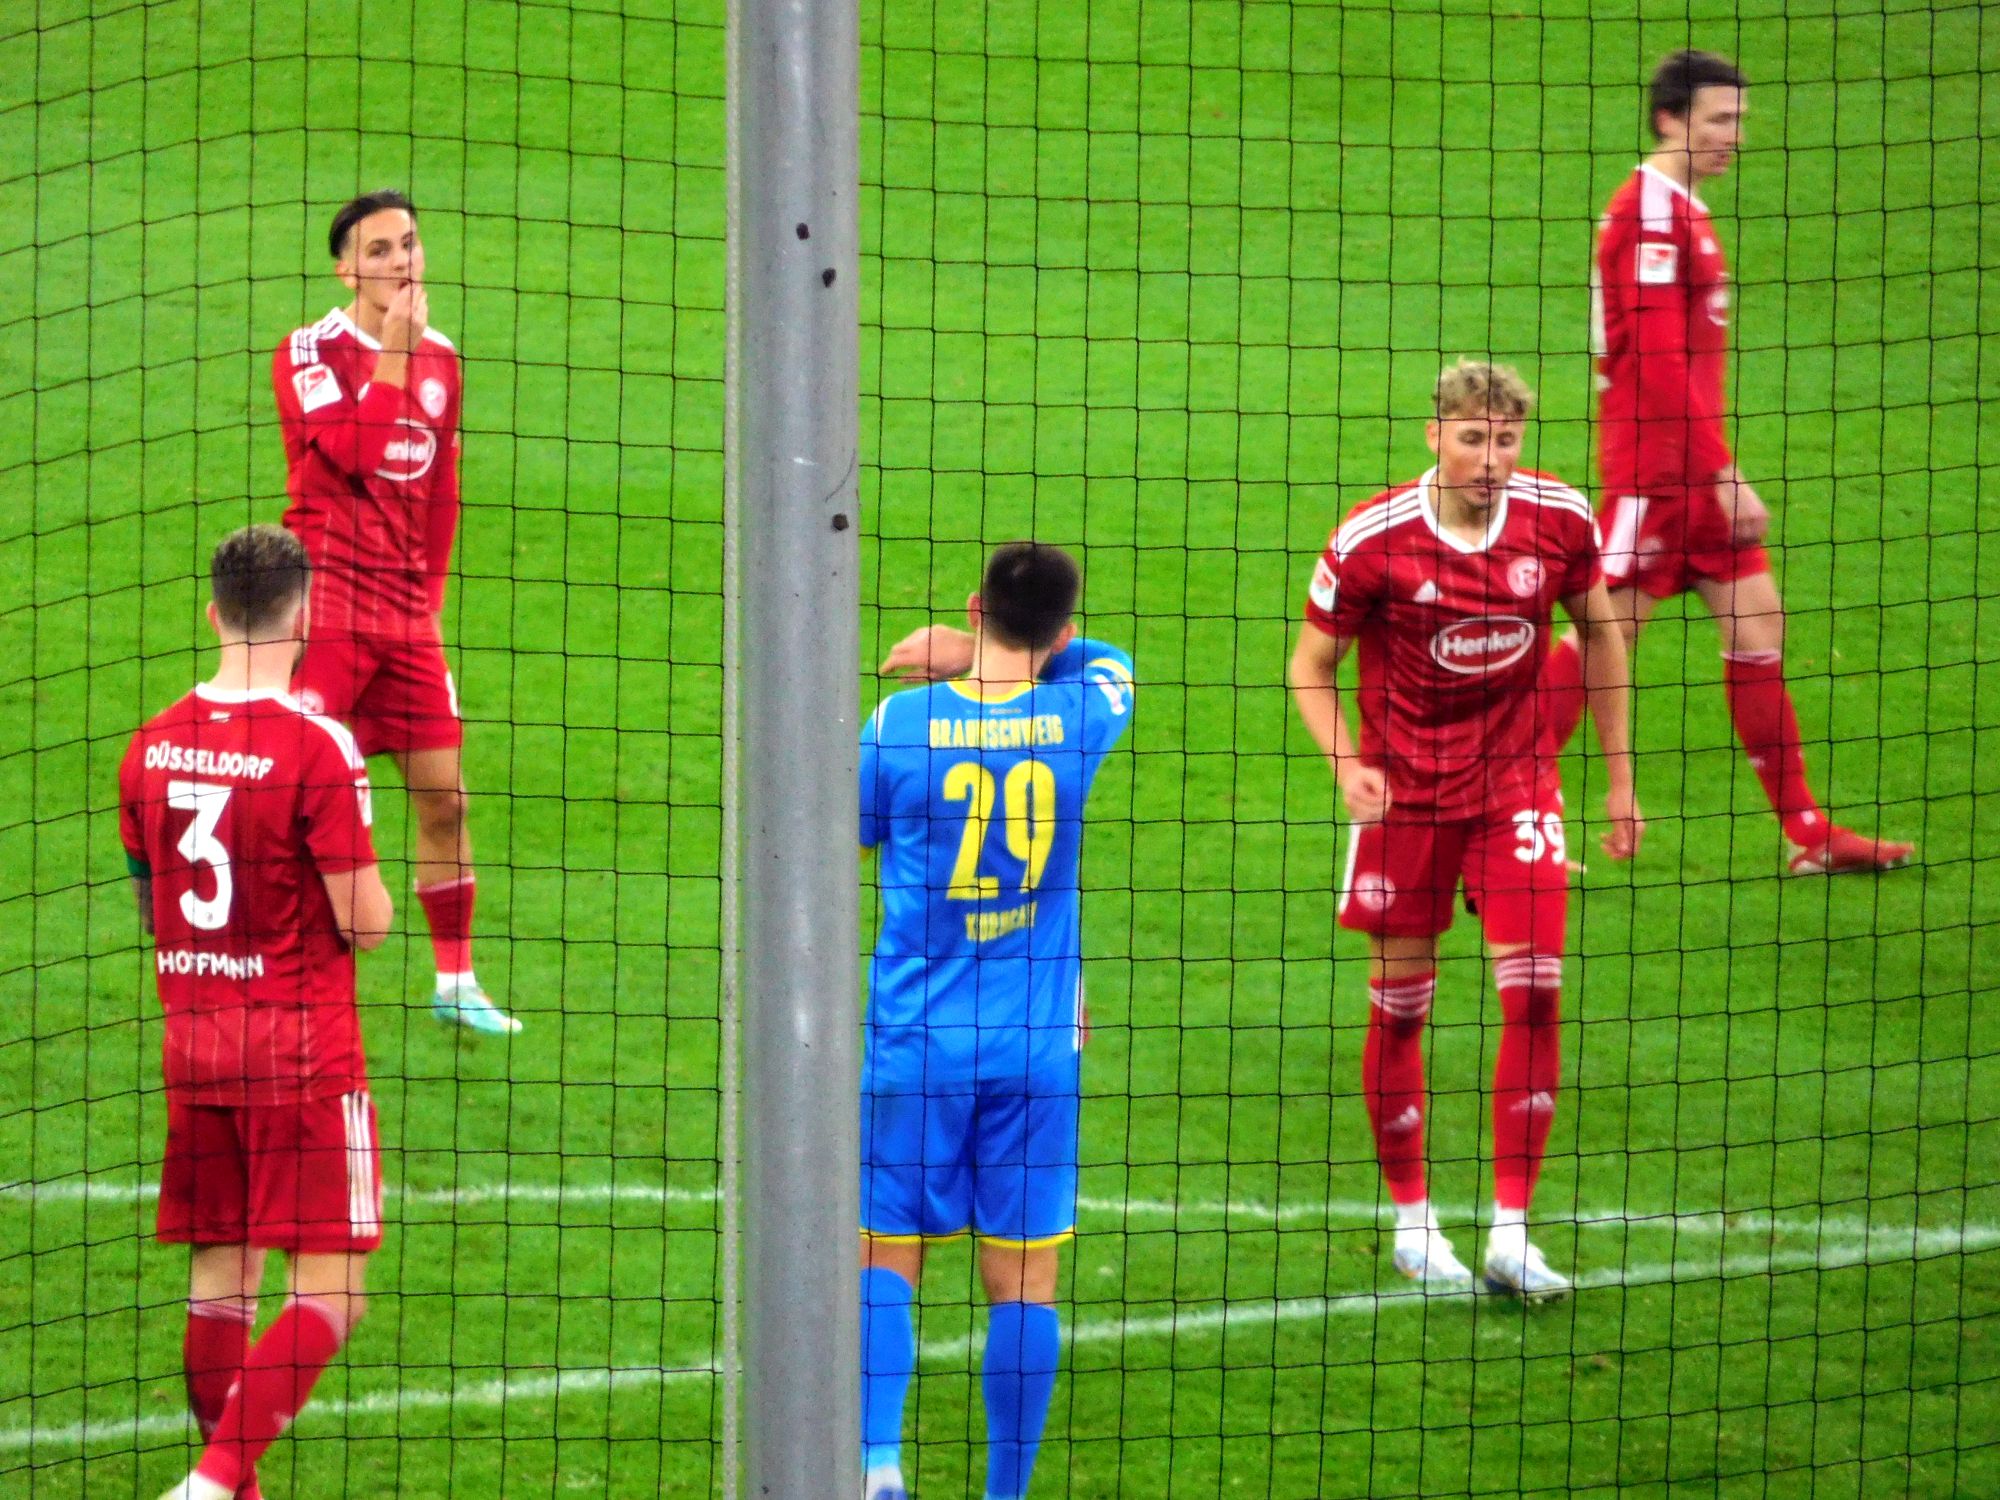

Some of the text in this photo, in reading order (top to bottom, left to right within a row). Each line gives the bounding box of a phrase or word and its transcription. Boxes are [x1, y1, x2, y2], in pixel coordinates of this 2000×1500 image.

[1441, 625, 1527, 657] Henkel
[929, 714, 1065, 749] BRAUNSCHWEIG
[145, 740, 274, 780] DÜSSELDORF
[943, 759, 1055, 900] 29
[1511, 808, 1565, 865] 39
[167, 780, 233, 930] 3
